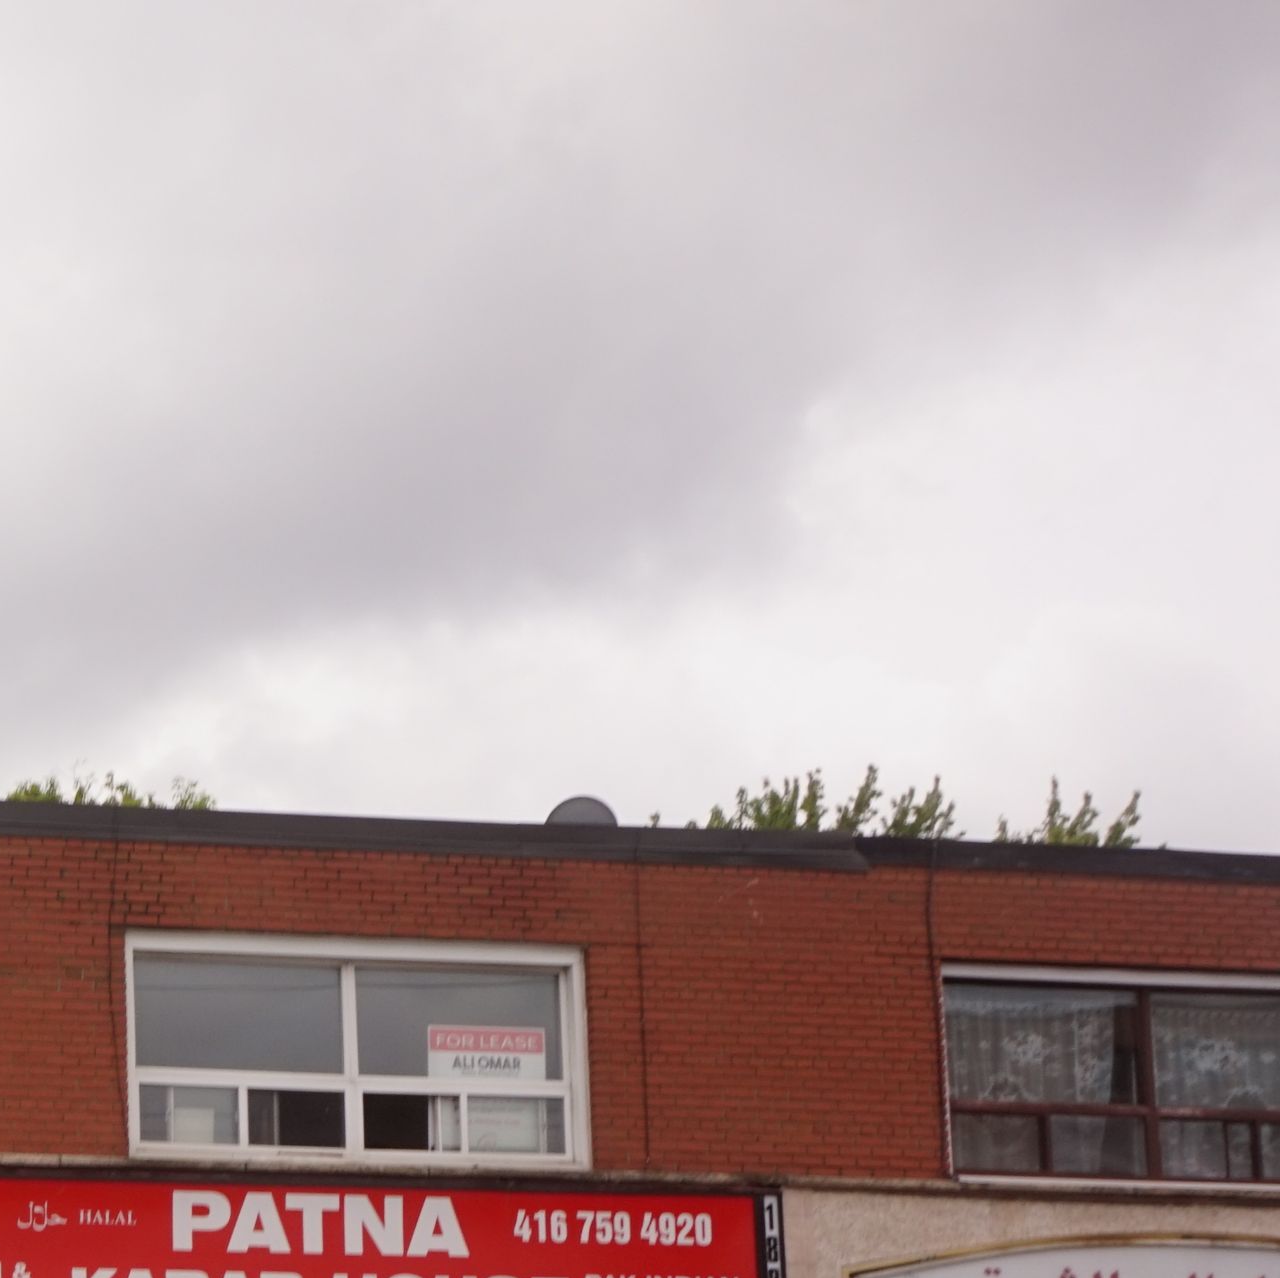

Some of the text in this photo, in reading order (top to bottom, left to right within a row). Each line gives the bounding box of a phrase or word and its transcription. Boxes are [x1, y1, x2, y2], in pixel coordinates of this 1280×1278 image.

[436, 1033, 538, 1050] FOR LEASE
[452, 1055, 521, 1071] ALI OMAR
[79, 1209, 137, 1226] HALAL
[172, 1189, 470, 1258] PATNA
[513, 1209, 713, 1247] 416 759 4920
